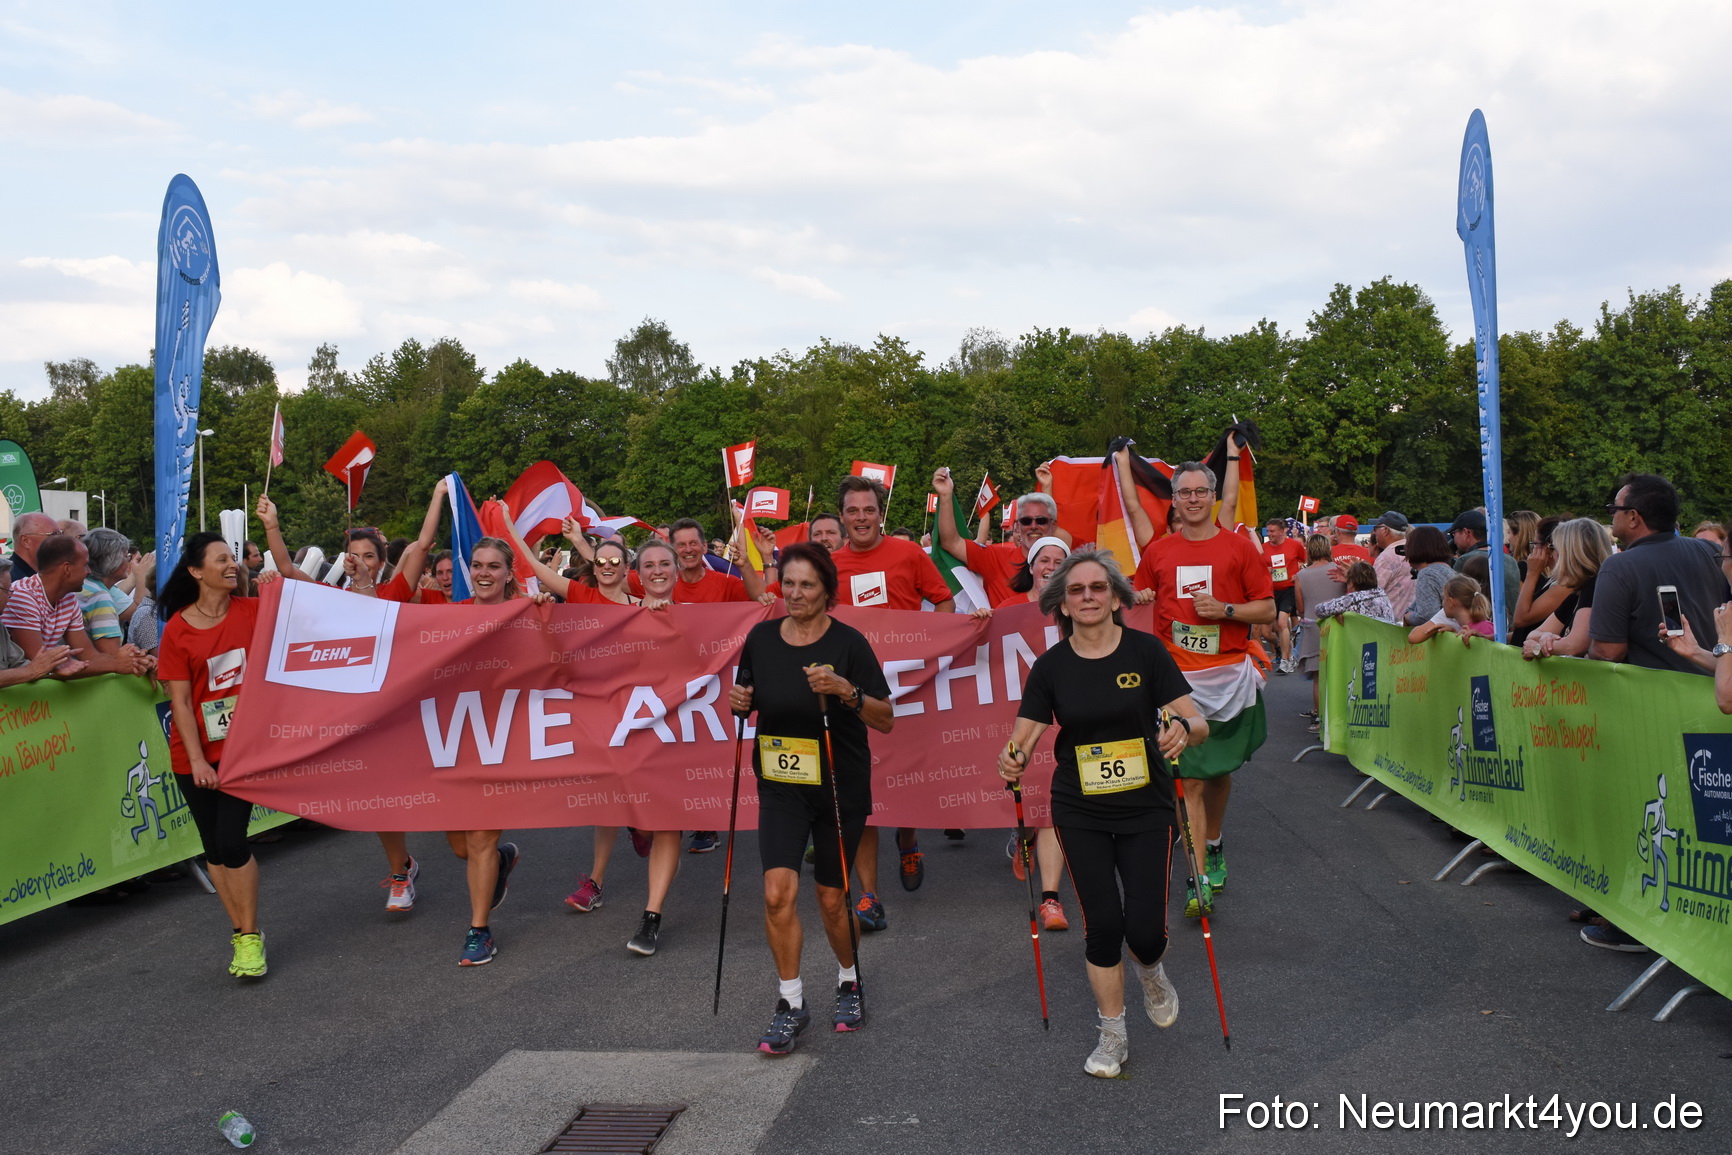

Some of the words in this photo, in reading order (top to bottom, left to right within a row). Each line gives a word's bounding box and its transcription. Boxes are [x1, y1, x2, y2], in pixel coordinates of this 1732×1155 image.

[420, 629, 460, 644] DEHN
[547, 616, 604, 634] setshaba.
[884, 629, 931, 644] chroni.
[310, 646, 351, 663] DEHN
[550, 650, 585, 664] DEHN
[590, 638, 660, 659] beschermt.
[1181, 636, 1208, 649] 478
[434, 661, 472, 680] DEHN
[475, 656, 513, 671] aabo.
[420, 688, 574, 768] WE
[883, 626, 1060, 717] EHN
[1511, 673, 1548, 708] Gesunde
[1551, 676, 1588, 707] Firmen
[1352, 693, 1391, 726] firmenlauf
[269, 724, 313, 739] DEHN
[942, 727, 981, 744] DEHN
[1558, 712, 1601, 762] länger!
[15, 721, 76, 771] länger!
[293, 758, 368, 777] chireletsa.
[685, 766, 723, 781] DEHN
[778, 753, 801, 770] 62
[1100, 760, 1126, 779] 56
[1466, 743, 1524, 788] firmenlauf
[482, 779, 527, 797] DEHN
[532, 775, 597, 792] protects.
[886, 771, 925, 789] DEHN
[928, 763, 981, 782] schützt.
[298, 800, 342, 816] DEHN
[346, 791, 441, 812] inochengeta.
[567, 791, 608, 808] DEHN
[613, 790, 650, 804] korur.
[683, 796, 722, 811] DEHN
[726, 794, 760, 810] pote
[939, 791, 976, 809] DEHN
[980, 783, 1042, 803] beskyter.
[1469, 789, 1495, 804] neumarkt
[0, 852, 97, 909] -oberpfalz.de
[1676, 896, 1730, 925] neumarkt
